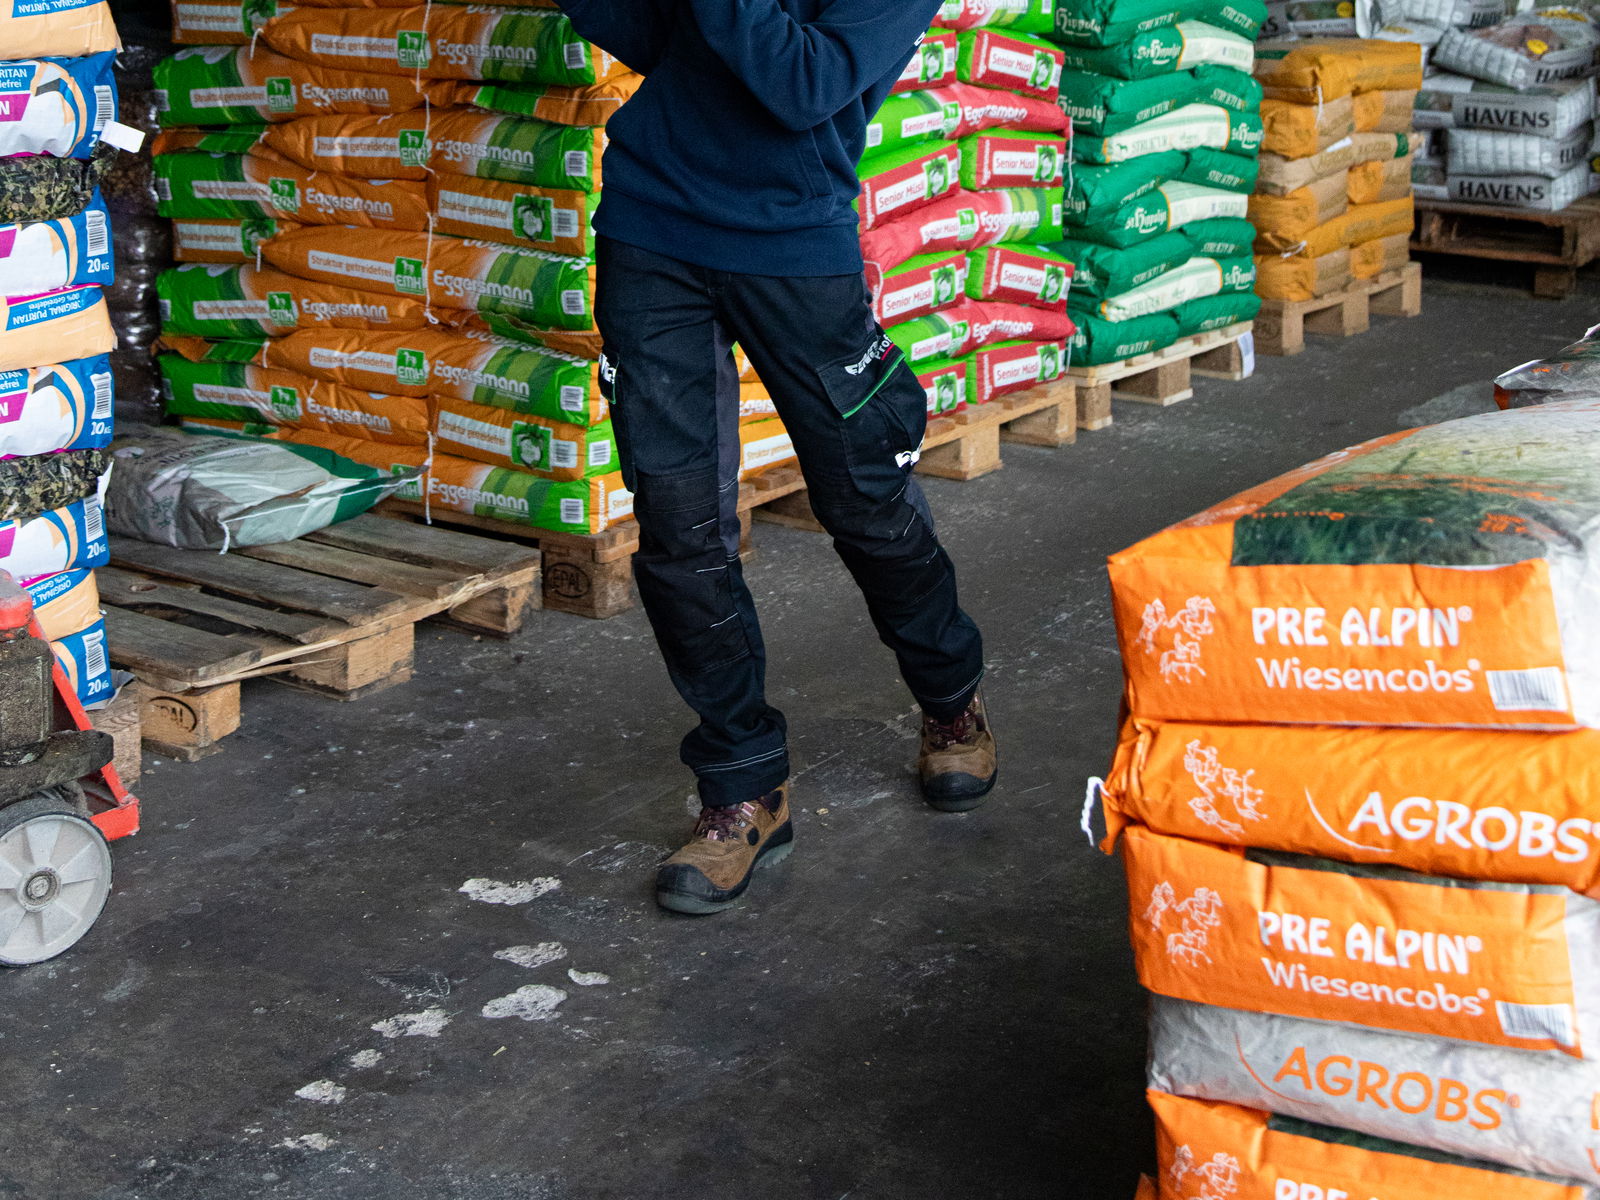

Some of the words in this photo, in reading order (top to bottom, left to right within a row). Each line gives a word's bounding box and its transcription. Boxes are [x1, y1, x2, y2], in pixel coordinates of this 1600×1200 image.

[436, 37, 537, 65] Eggersmann
[992, 53, 1014, 68] Senior
[1014, 59, 1034, 73] Müsli
[301, 82, 389, 107] Eggersmann
[904, 120, 925, 134] Senior
[1463, 105, 1550, 130] HAVENS
[436, 137, 535, 164] Eggersmann
[995, 157, 1017, 170] Senior
[878, 192, 904, 210] Senior
[905, 180, 925, 199] Müsli
[1458, 175, 1545, 202] HAVENS
[305, 186, 393, 217] Eggersmann
[87, 259, 101, 274] 20
[1003, 269, 1026, 285] Senior
[395, 275, 425, 291] EMH
[433, 268, 534, 304] Eggersmann
[28, 296, 65, 311] Getreidefrei
[301, 298, 388, 321] Eggersmann
[885, 295, 911, 314] Senior
[912, 284, 932, 303] Müsli
[13, 309, 47, 325] PURITAN
[396, 366, 425, 382] EMH
[433, 359, 530, 396] Eggersmann
[996, 367, 1021, 383] Senior
[1021, 361, 1039, 377] Müsli
[429, 477, 529, 511] Eggersmann
[86, 542, 100, 560] 20
[36, 578, 72, 602] ORIGINAL
[551, 568, 583, 593] EPAL
[1251, 605, 1327, 647] PRE
[87, 679, 101, 696] 20
[1257, 910, 1335, 960] PRE
